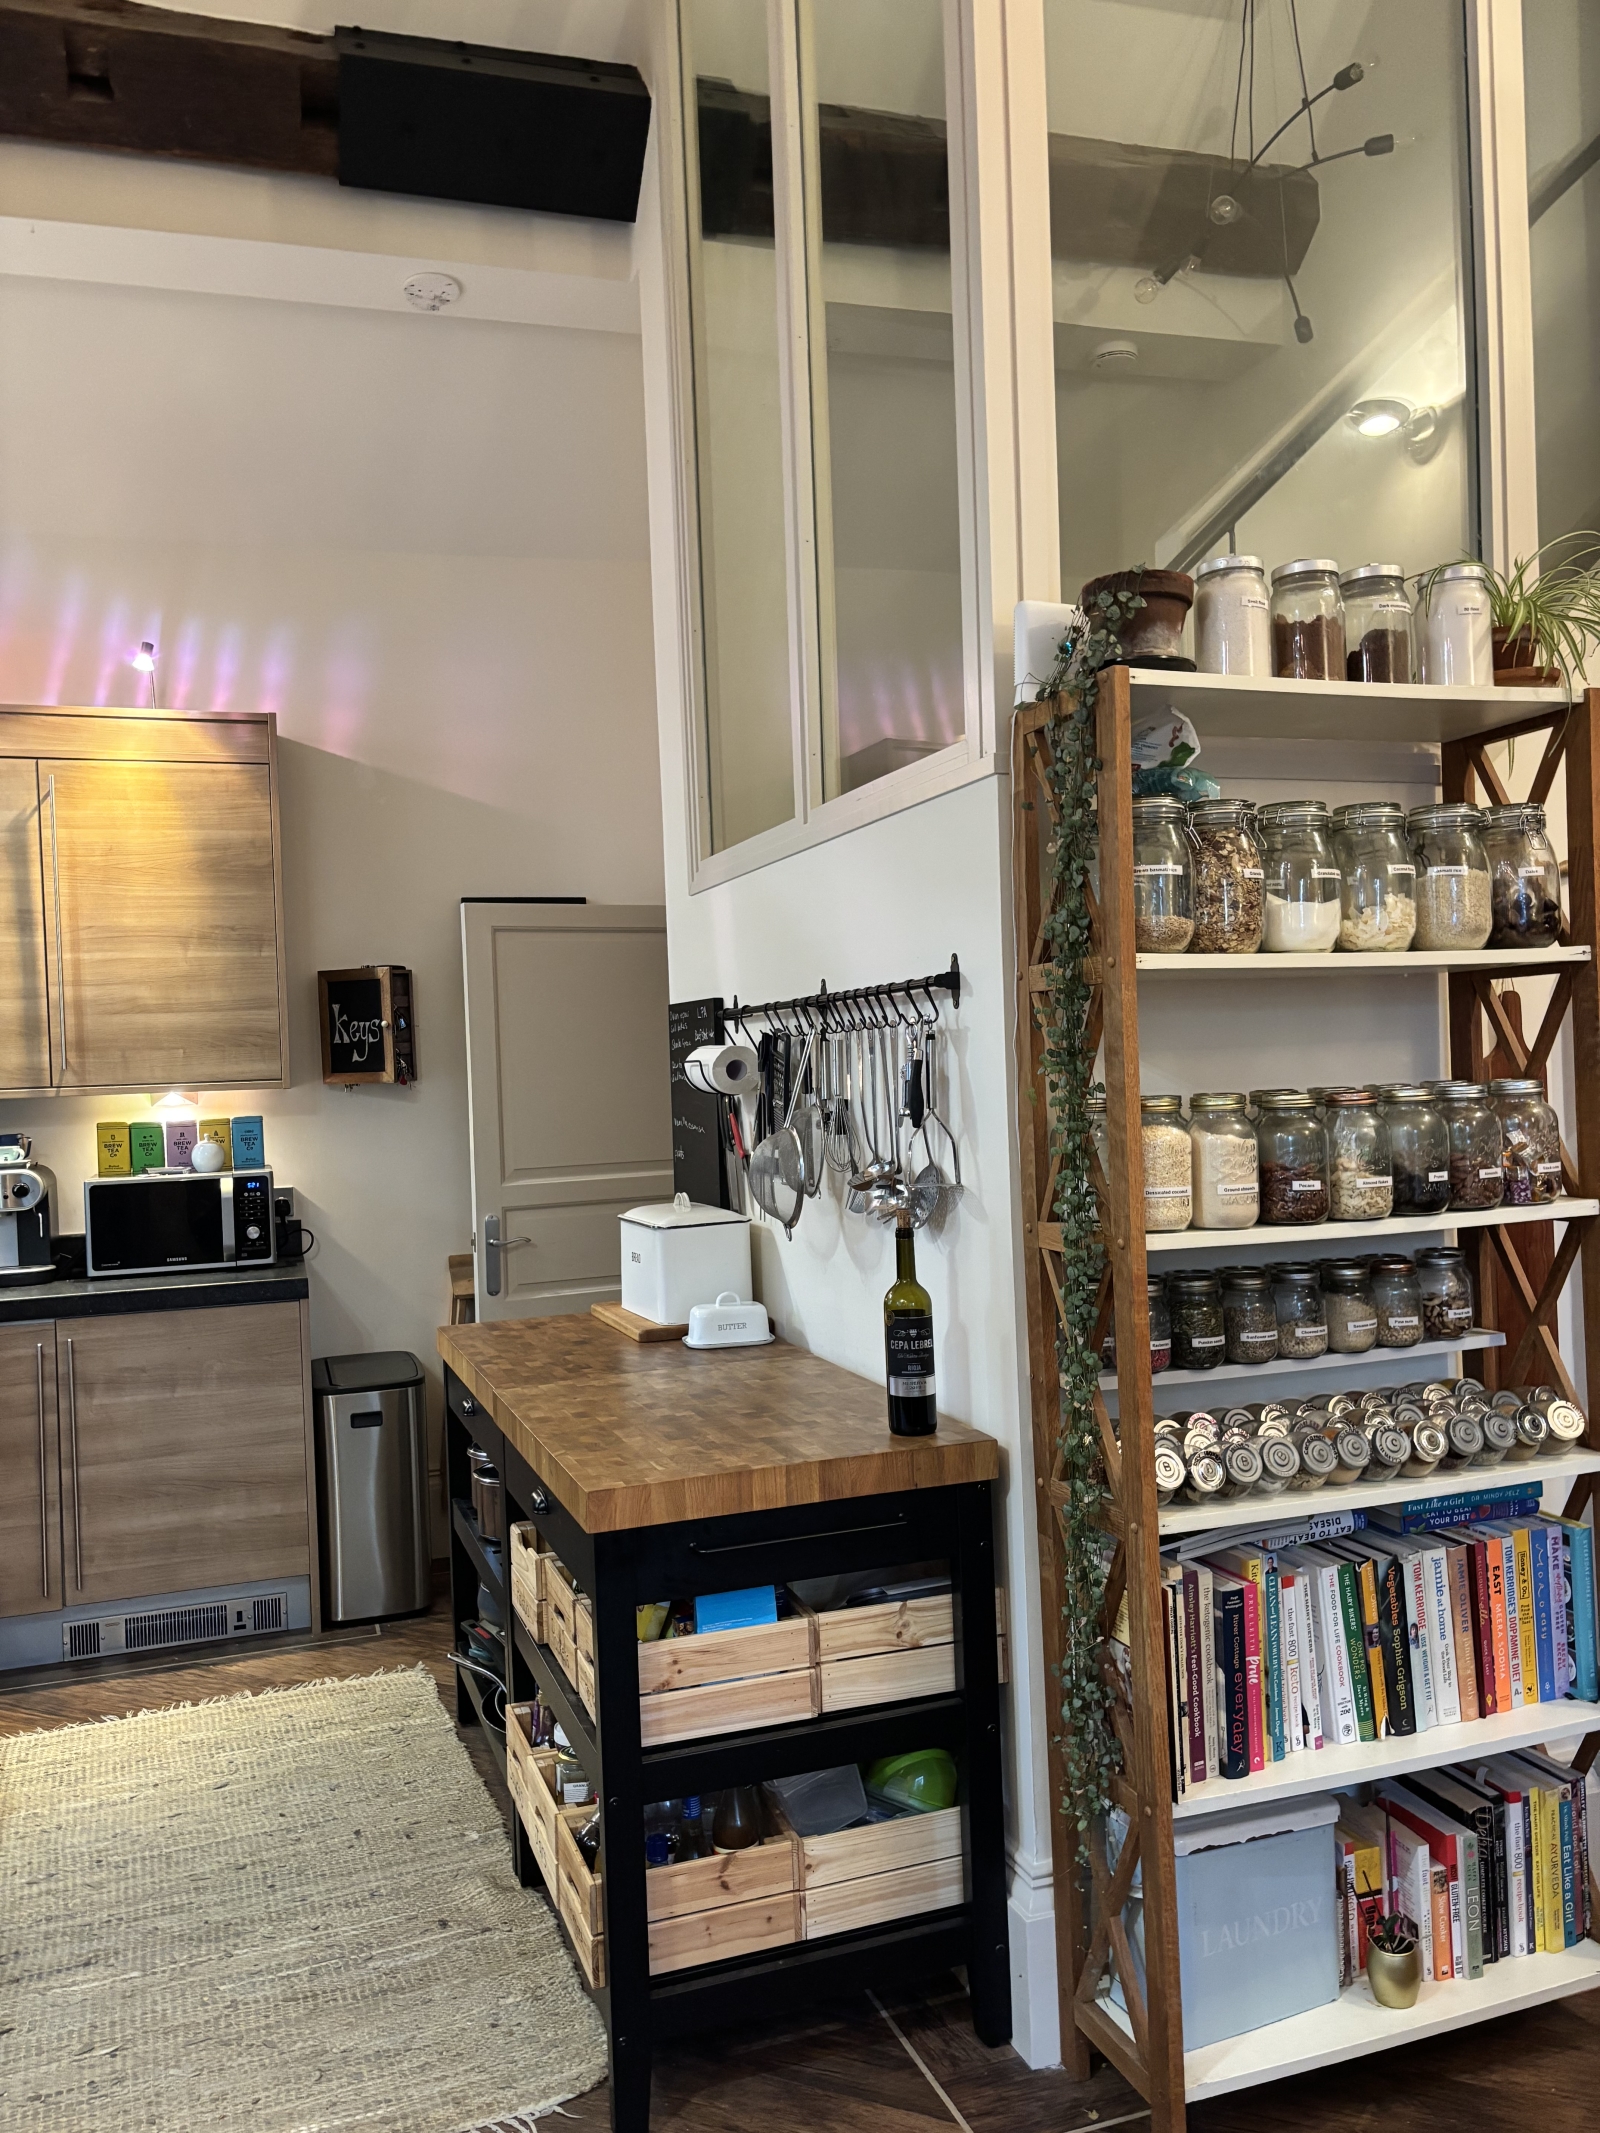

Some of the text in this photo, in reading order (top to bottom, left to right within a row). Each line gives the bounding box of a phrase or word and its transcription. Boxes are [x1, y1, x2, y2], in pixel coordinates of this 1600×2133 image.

[332, 1004, 380, 1062] Keys
[631, 1252, 641, 1263] BREAD
[717, 1322, 747, 1331] BUTTER
[890, 1339, 933, 1350] CEPA LEBREL
[1408, 1503, 1423, 1511] Fast
[1425, 1498, 1441, 1509] Like
[1450, 1497, 1464, 1506] Girl
[1483, 1491, 1503, 1500] MINDY
[1430, 1513, 1470, 1525] YOUR DIET
[1320, 1525, 1352, 1538] EAT TO
[1519, 1552, 1527, 1577] Honey
[1551, 1536, 1560, 1571] MAKE
[1203, 1587, 1211, 1601] the
[1268, 1576, 1278, 1606] CLEAN
[1345, 1587, 1353, 1607] HAIRY
[1366, 1566, 1378, 1621] Jamie Oliver
[1386, 1566, 1399, 1626] Vegetables
[1413, 1562, 1427, 1632] TOM KERRIDGE
[1431, 1557, 1446, 1598] jamie
[1457, 1558, 1470, 1633] JAMIE OLIVER
[1477, 1555, 1485, 1600] DELICIOUSLY
[1203, 1602, 1213, 1641] ketogenic
[1267, 1614, 1278, 1641] LEAN
[1437, 1609, 1447, 1641] home
[1492, 1565, 1506, 1680] EAST MEERA SODHA
[1504, 1545, 1521, 1683] TOM KERRIDGE'S DOPAMINE DIET
[1233, 1637, 1241, 1669] Cottage
[1288, 1639, 1297, 1657] 800
[1330, 1589, 1338, 1610] FOOD
[1336, 1645, 1345, 1688] COOKBOOK
[1392, 1628, 1405, 1667] Sophie
[1187, 1584, 1201, 1737] Ainsley Harriott's Feel-Good Cookbook
[1204, 1644, 1214, 1685] cookbook
[1350, 1637, 1361, 1680] WONDERS
[1290, 1667, 1299, 1695] keto
[1396, 1667, 1408, 1711] Grigson
[1466, 1678, 1475, 1700] Italy
[1230, 1672, 1244, 1755] everyday
[1514, 1852, 1523, 1869] 800
[1551, 1843, 1559, 1899] AYURVEDA
[1563, 1845, 1571, 1864] Eat
[1563, 1866, 1573, 1890] Like
[1439, 1896, 1448, 1943] Slow Cooker
[1451, 1883, 1460, 1923] GLUTEN-FREE
[1467, 1887, 1479, 1932] LEON
[1565, 1902, 1574, 1923] Girl
[1200, 1896, 1323, 1957] LAUNDRY
